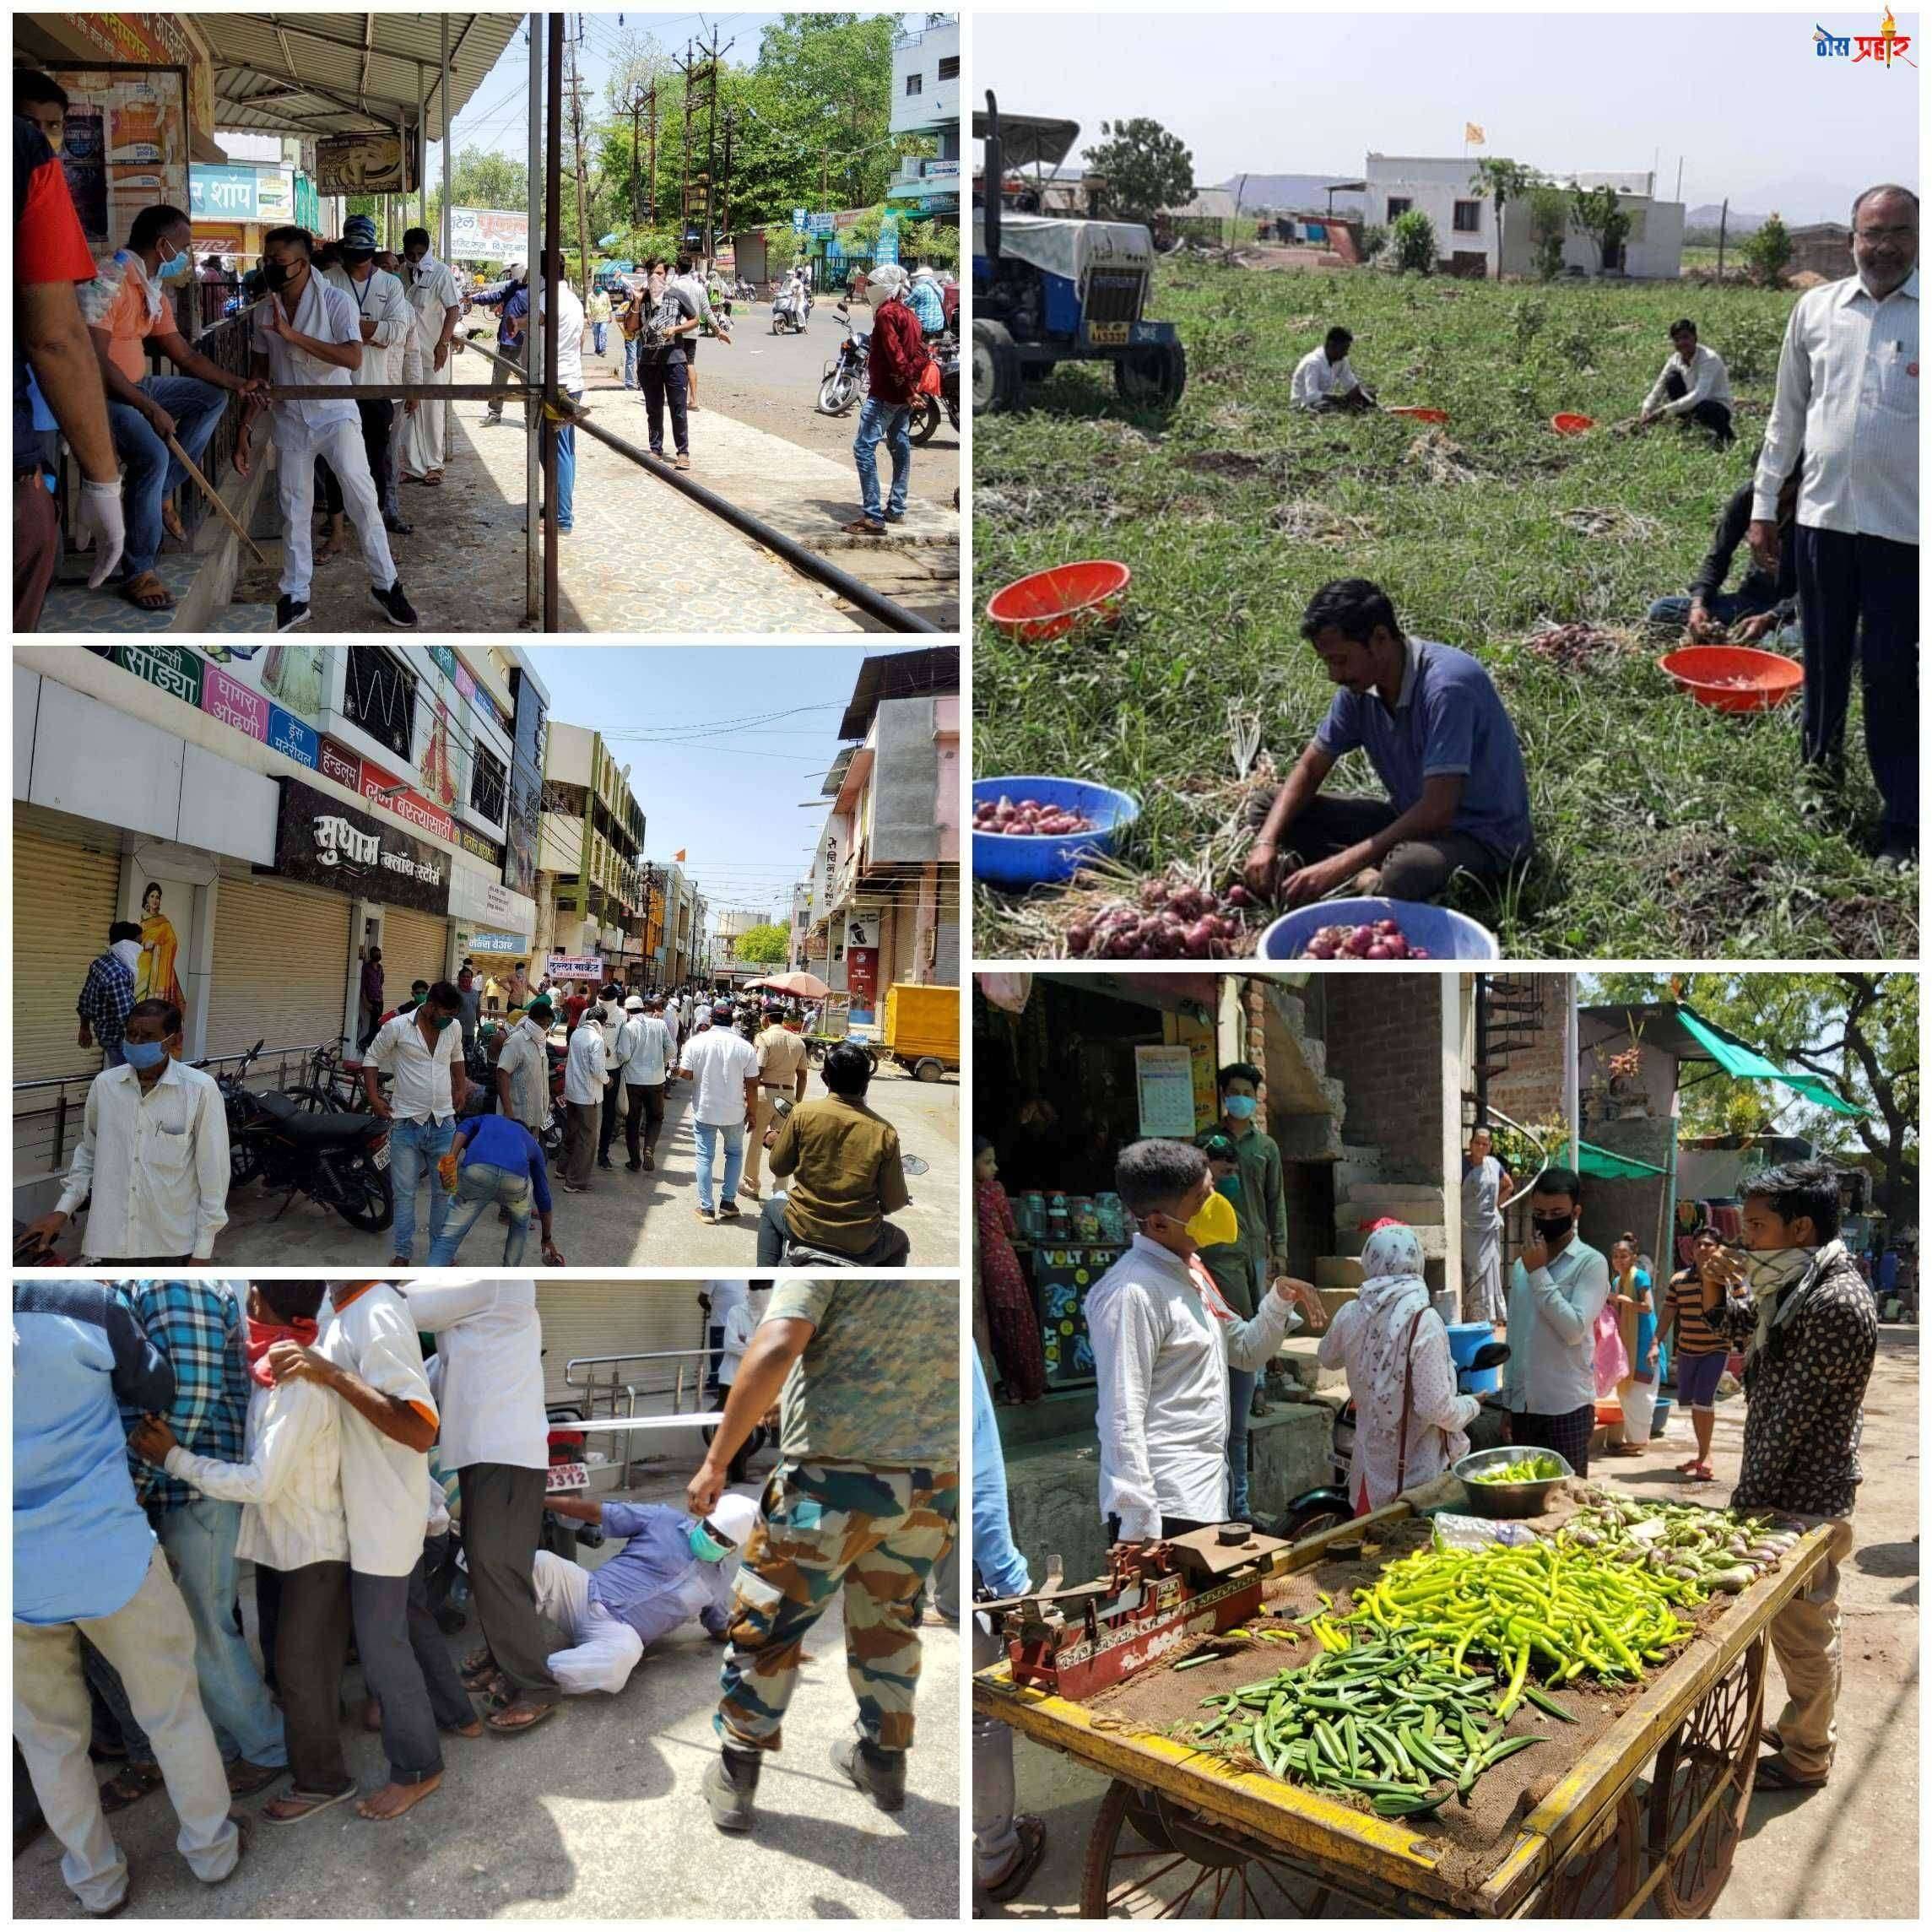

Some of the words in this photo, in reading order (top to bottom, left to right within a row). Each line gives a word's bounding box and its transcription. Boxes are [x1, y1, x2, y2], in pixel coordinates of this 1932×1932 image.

[211, 174, 252, 209] शॉप
[127, 646, 196, 703] साड्या
[218, 675, 258, 712] घागरा
[214, 701, 259, 739] ओढणी
[289, 717, 304, 742] ड्रेस
[322, 745, 357, 790] हॅन्डलूम
[397, 797, 452, 842] बस्त्यांसाठी
[314, 815, 381, 866] सुधाम
[381, 850, 414, 876] क्लॉथ
[1043, 1250, 1082, 1265] VOLT
[1044, 1326, 1058, 1372] VOLT
